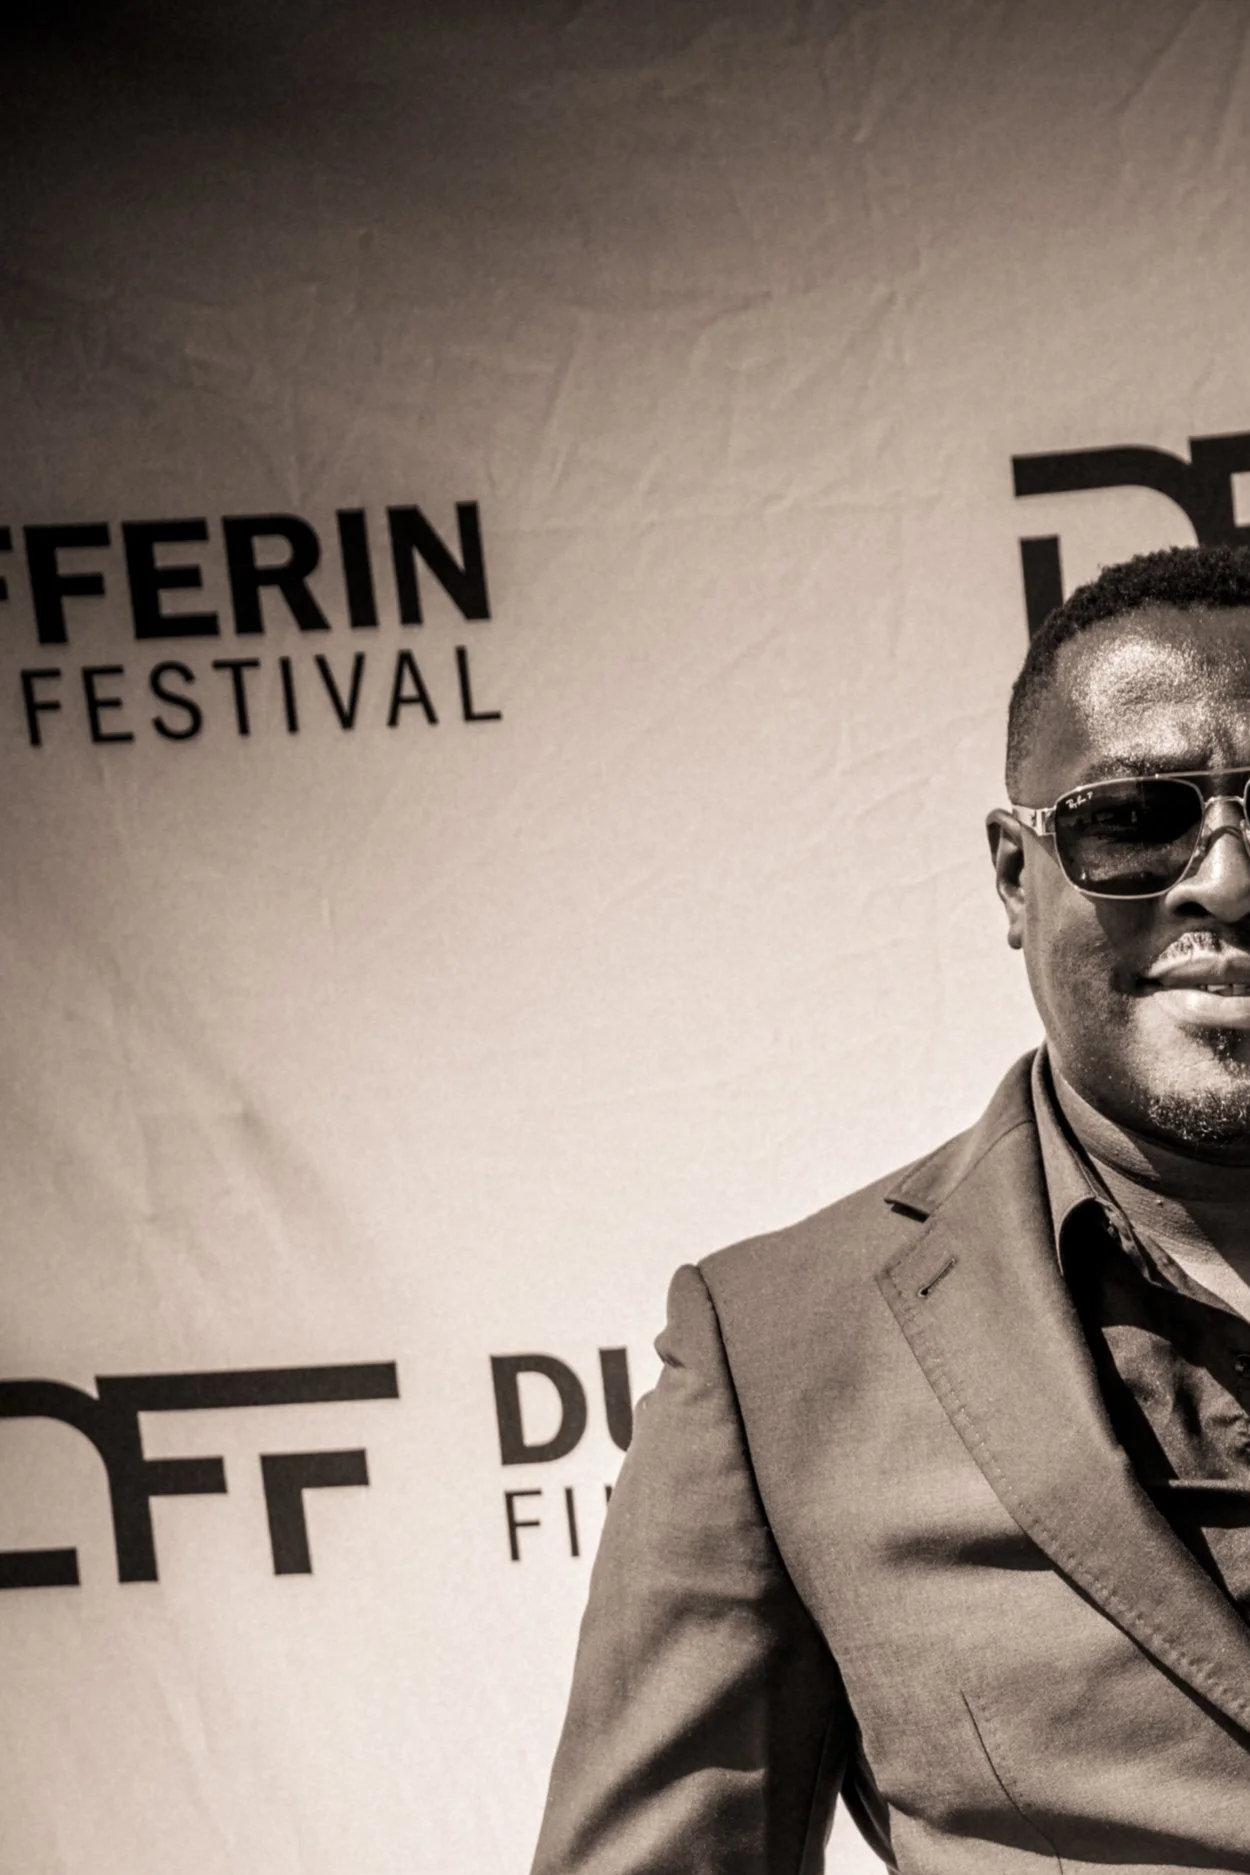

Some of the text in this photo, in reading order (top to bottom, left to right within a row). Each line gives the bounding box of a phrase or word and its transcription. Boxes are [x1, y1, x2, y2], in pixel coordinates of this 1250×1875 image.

[0, 500, 491, 645] FERIN
[20, 645, 503, 747] FESTIVAL
[505, 1486, 613, 1562] FI
